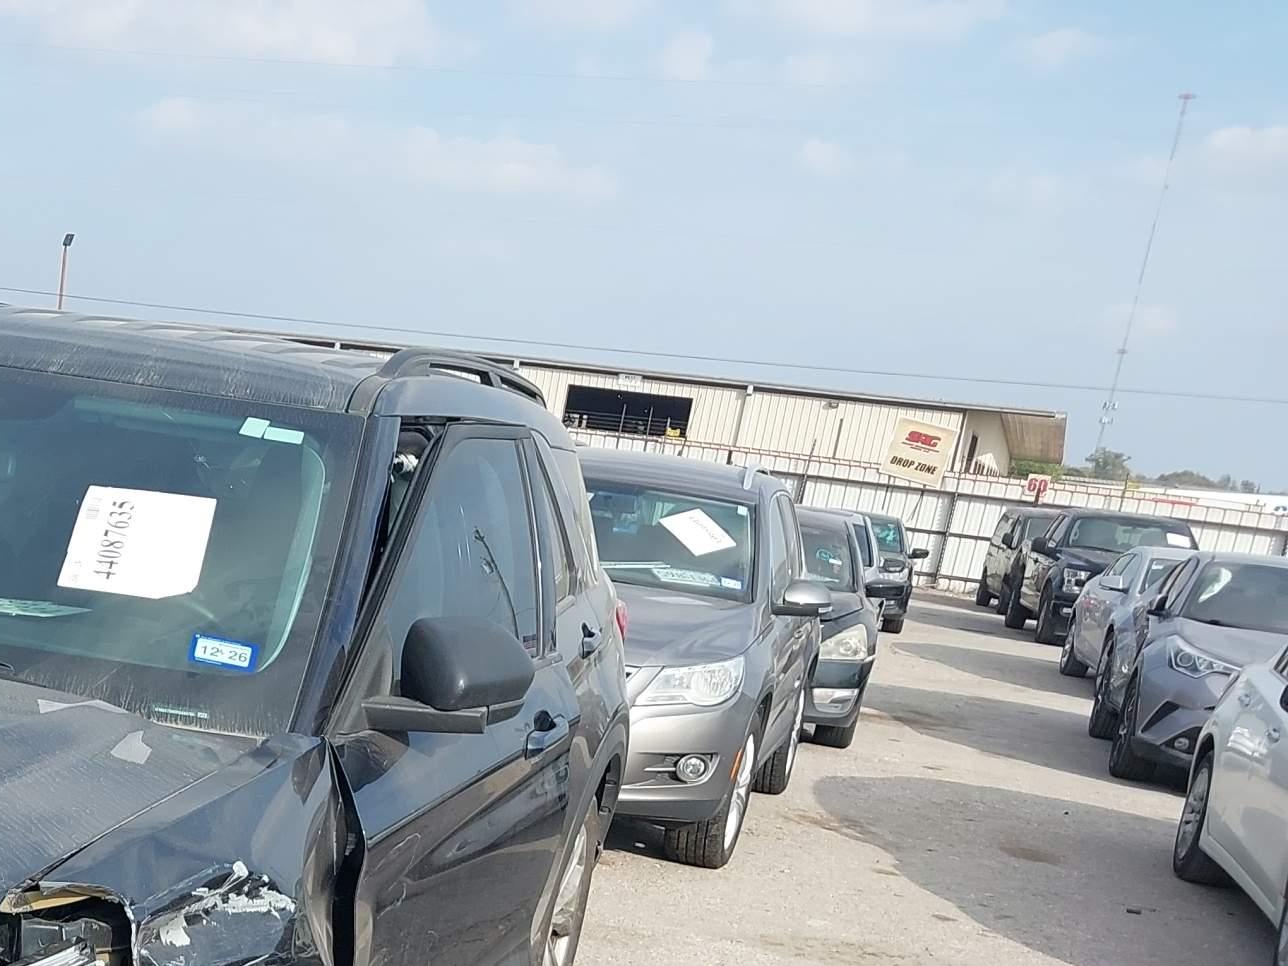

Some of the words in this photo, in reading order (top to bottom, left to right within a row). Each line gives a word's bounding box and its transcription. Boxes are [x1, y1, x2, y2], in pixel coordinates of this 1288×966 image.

[890, 455, 915, 469] DROP
[914, 461, 938, 475] ZONE
[1027, 478, 1049, 493] 60
[93, 500, 135, 580] 44087635
[228, 650, 248, 663] 26
